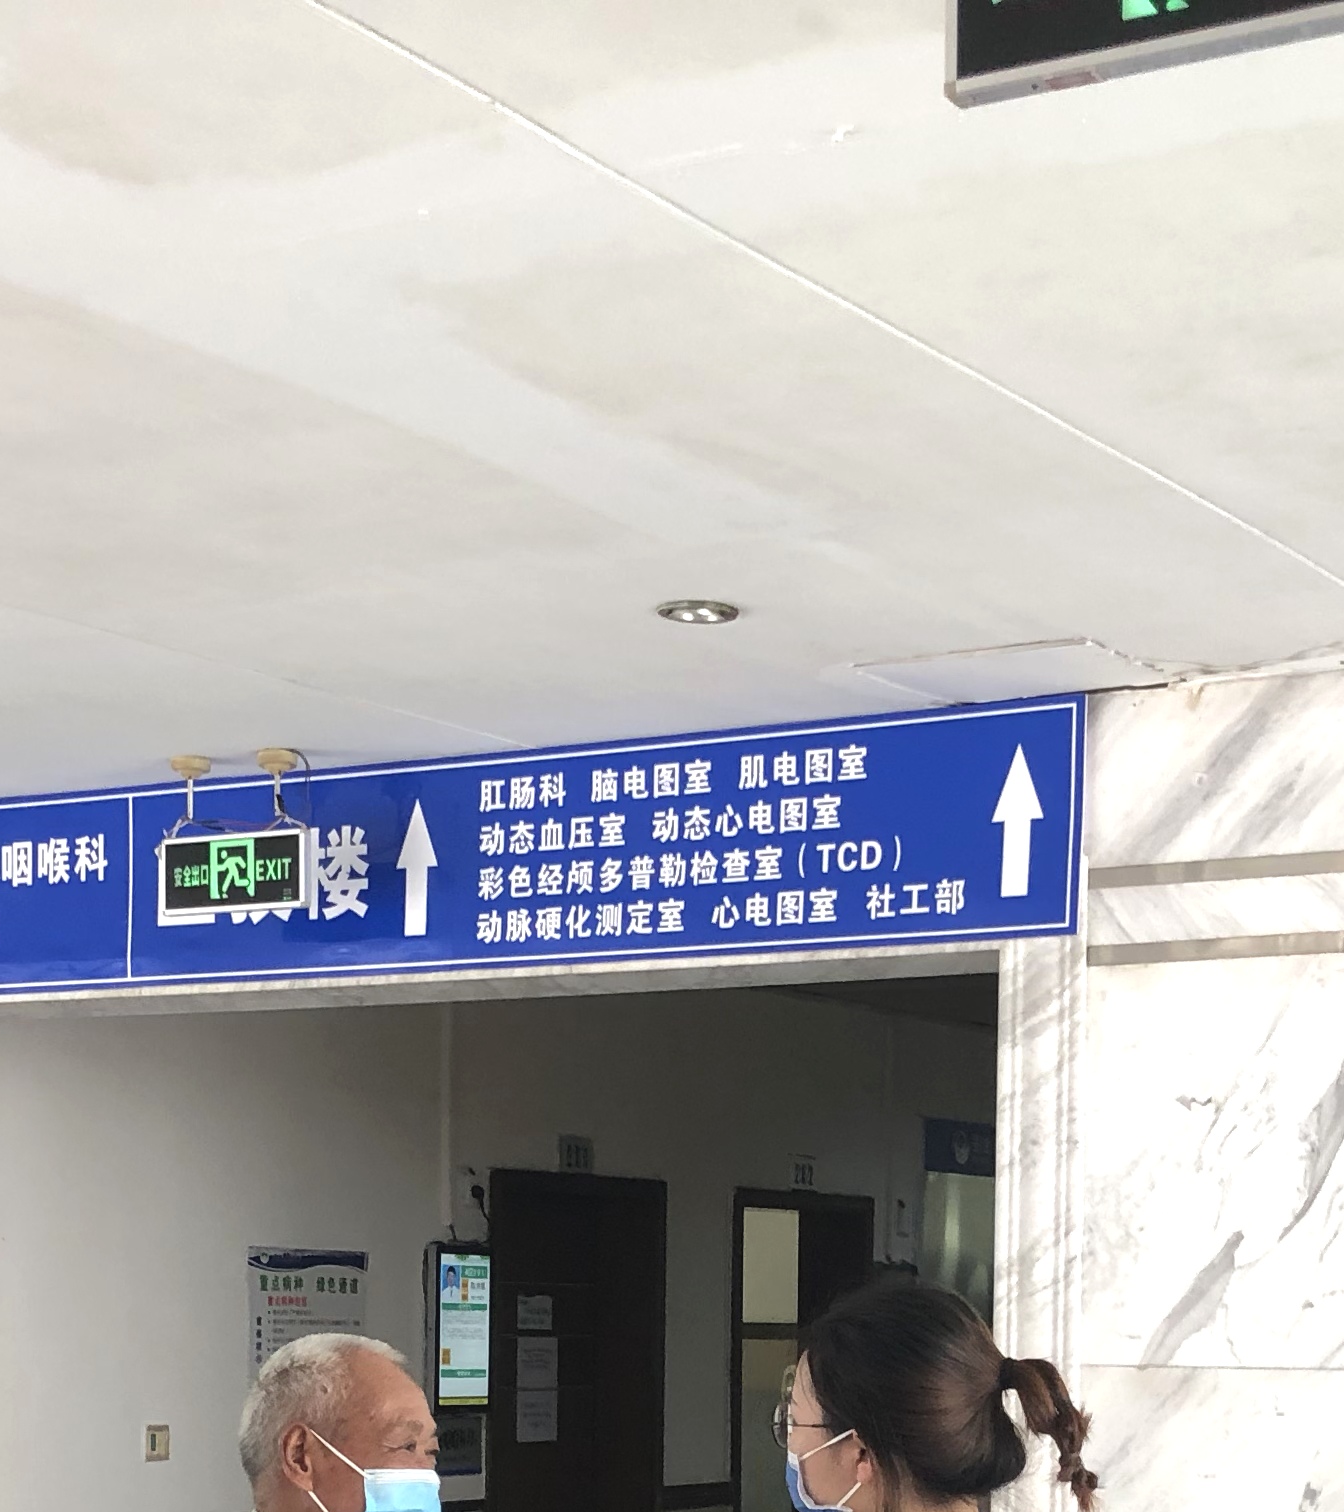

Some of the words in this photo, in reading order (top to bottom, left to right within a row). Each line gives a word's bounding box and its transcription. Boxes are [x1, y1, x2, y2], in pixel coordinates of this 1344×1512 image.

[479, 771, 567, 813] 肛肠科
[590, 758, 712, 803] 脑电图室
[738, 743, 868, 790] 肌电图室
[479, 811, 626, 857] 动态血压室
[652, 793, 842, 843] 动态心电图室
[173, 863, 209, 889] 安全出口
[256, 857, 293, 882] EXIT
[476, 897, 685, 944] 动脉硬化测定室
[711, 886, 838, 929] 心电图室
[865, 878, 966, 921] 社工部
